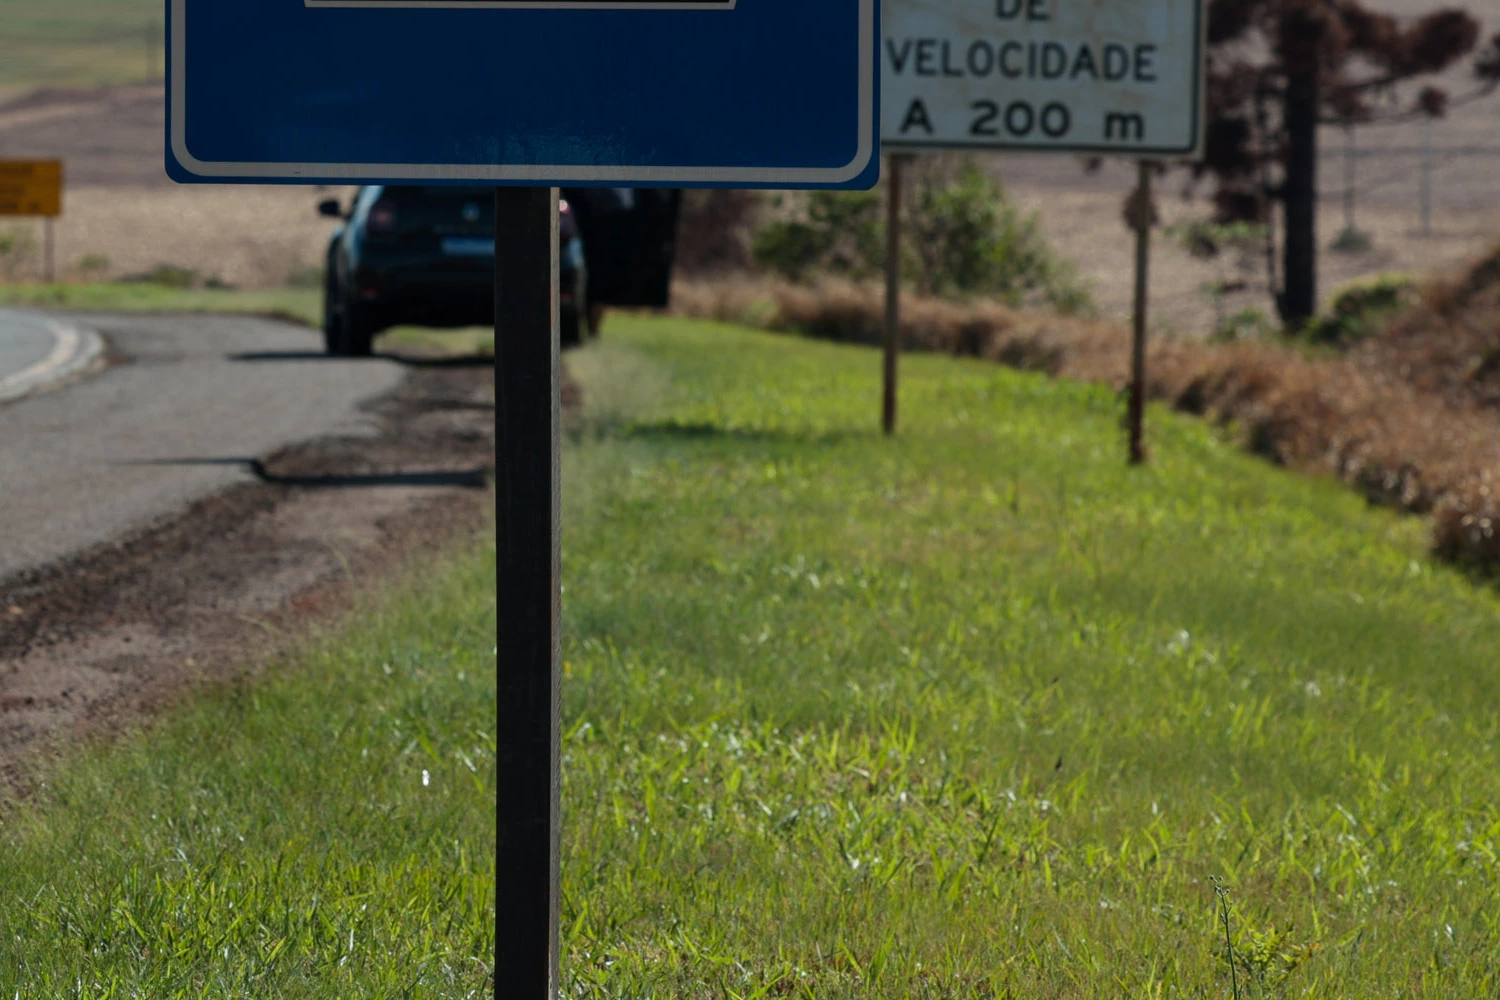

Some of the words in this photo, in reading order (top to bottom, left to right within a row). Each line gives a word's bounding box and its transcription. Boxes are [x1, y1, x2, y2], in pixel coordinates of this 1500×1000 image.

[885, 38, 1158, 82] VELOCIDADE
[900, 97, 934, 135] A
[969, 100, 1071, 138] 200
[1104, 110, 1146, 141] m
